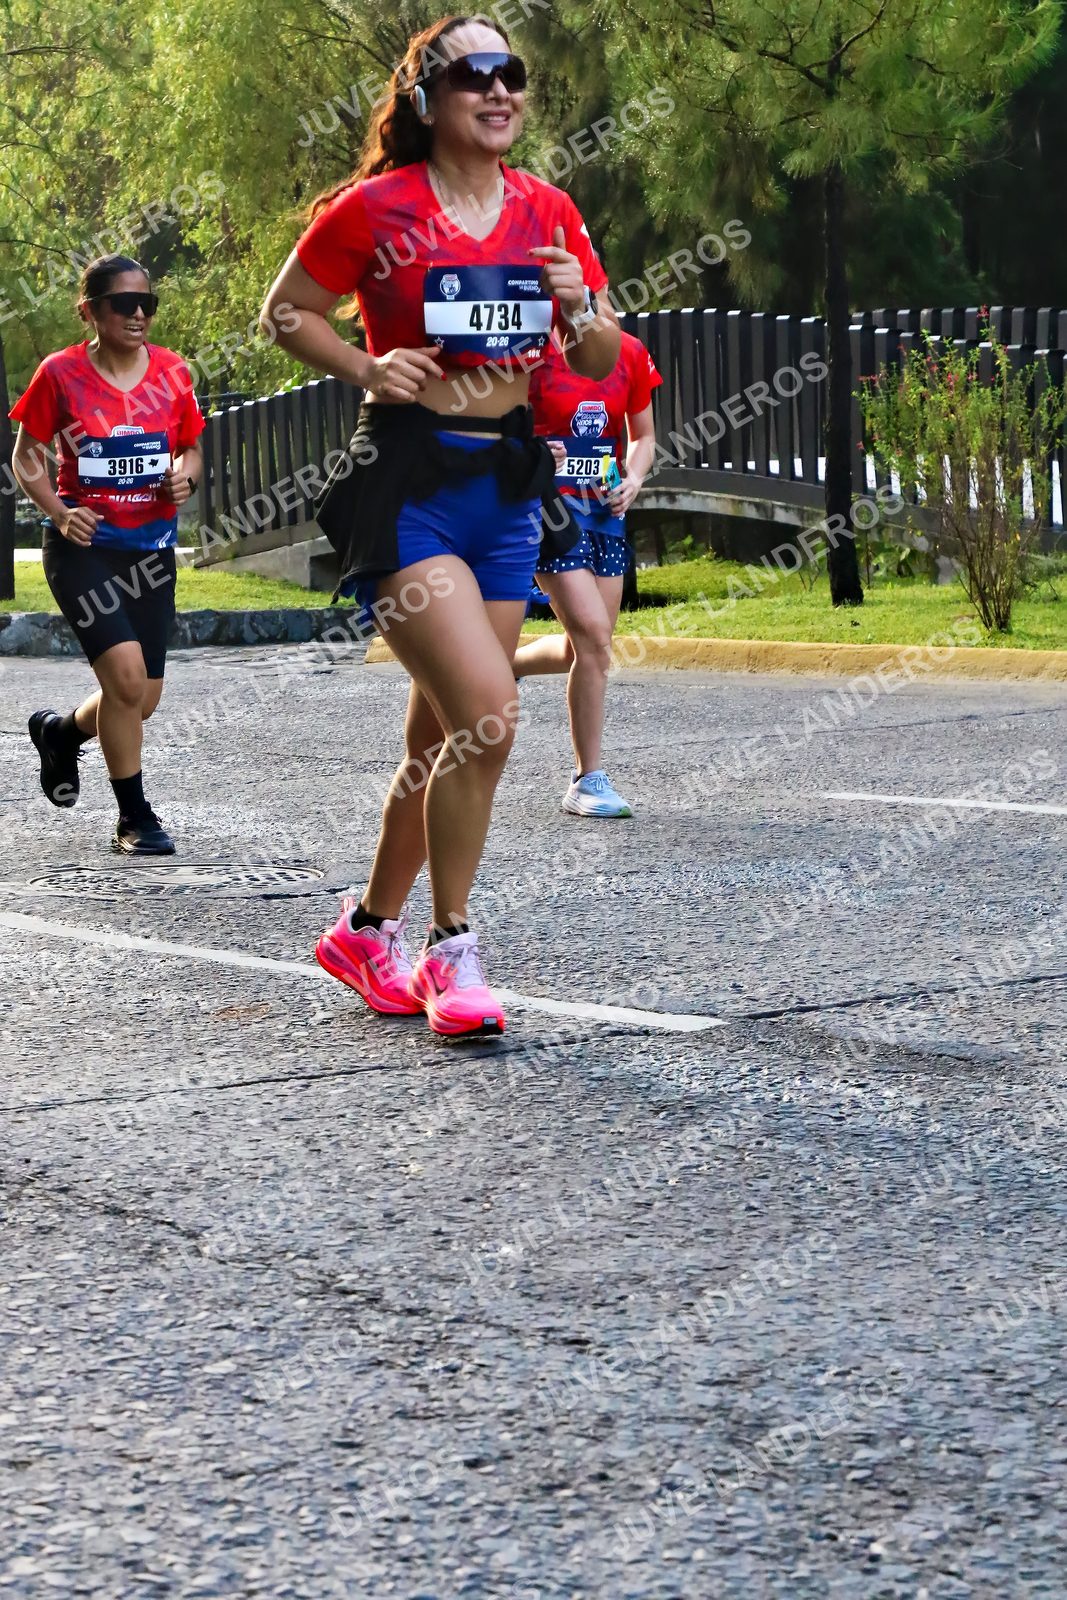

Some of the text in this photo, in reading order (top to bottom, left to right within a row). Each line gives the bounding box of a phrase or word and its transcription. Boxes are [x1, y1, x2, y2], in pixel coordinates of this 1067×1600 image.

[469, 302, 522, 331] 4734
[527, 349, 541, 358] 10K
[108, 457, 144, 476] 3916
[567, 459, 600, 476] 5203
